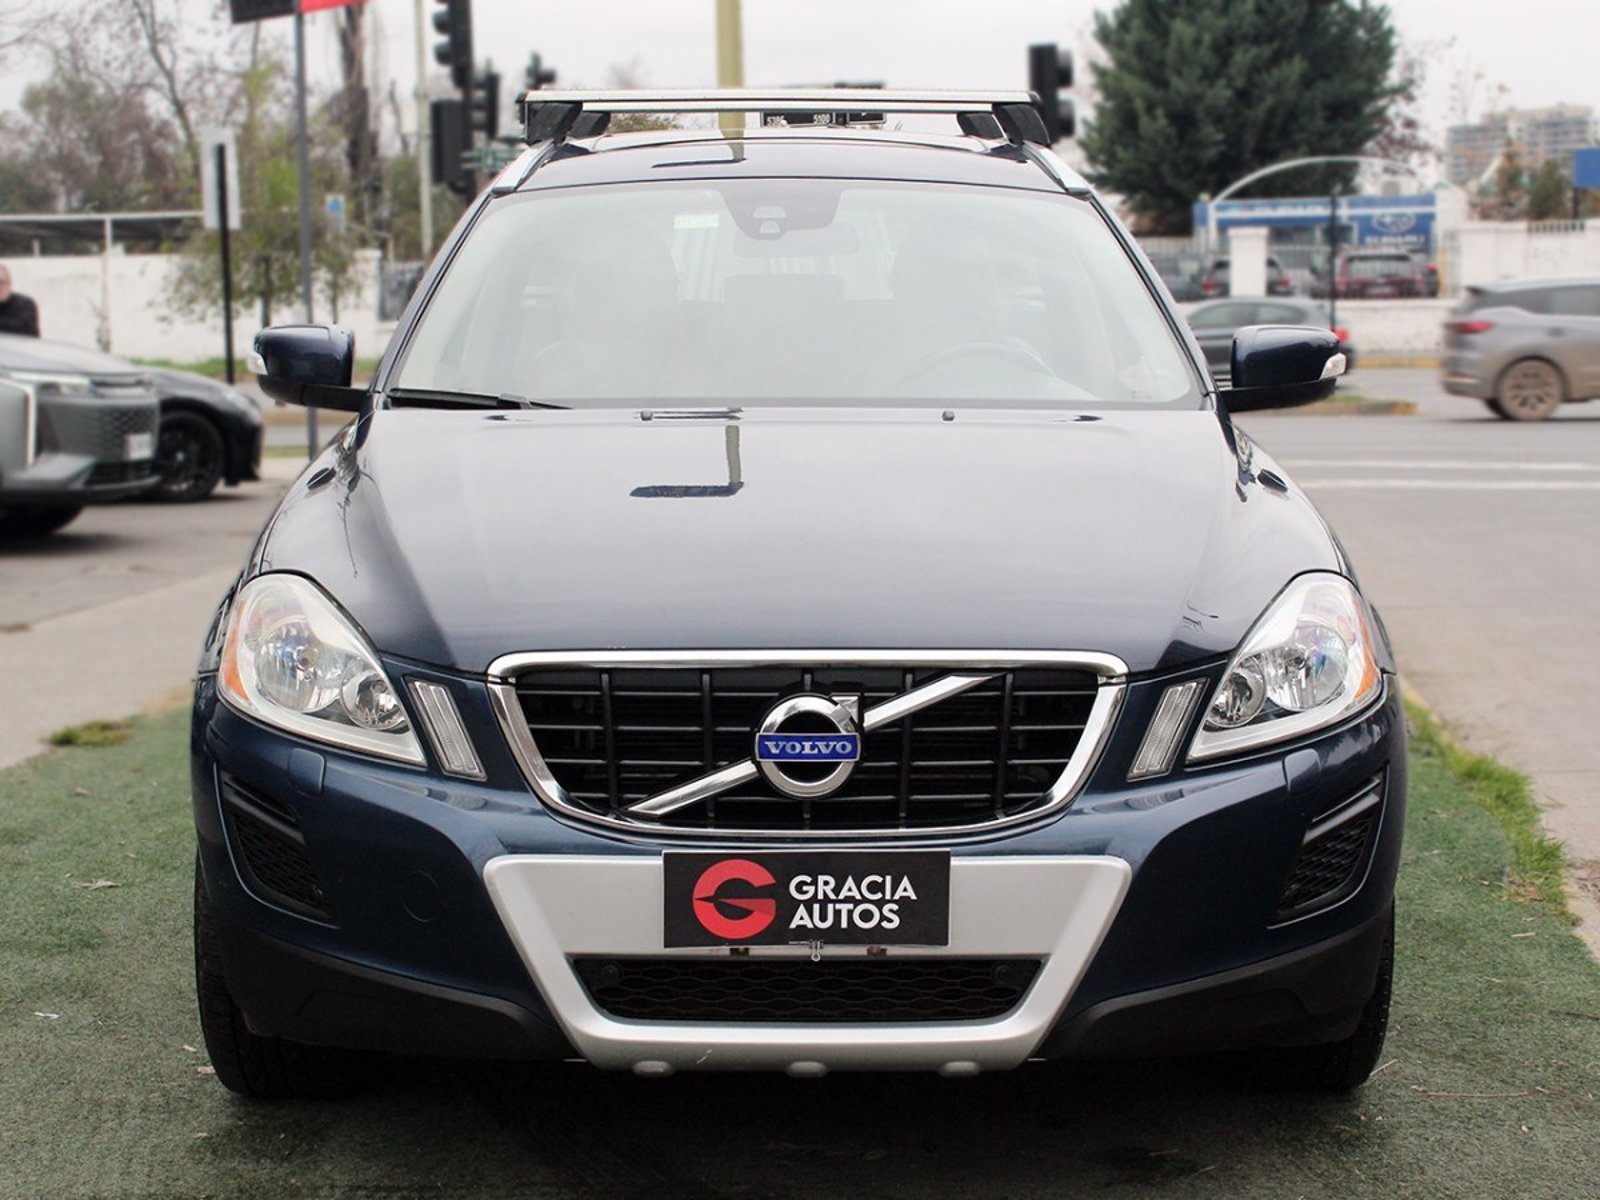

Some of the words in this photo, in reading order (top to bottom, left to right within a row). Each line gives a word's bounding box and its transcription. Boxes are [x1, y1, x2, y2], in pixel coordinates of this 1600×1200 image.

[764, 741, 852, 754] VOLVO
[788, 874, 918, 900] GRACIA
[788, 903, 900, 929] AUTOS
